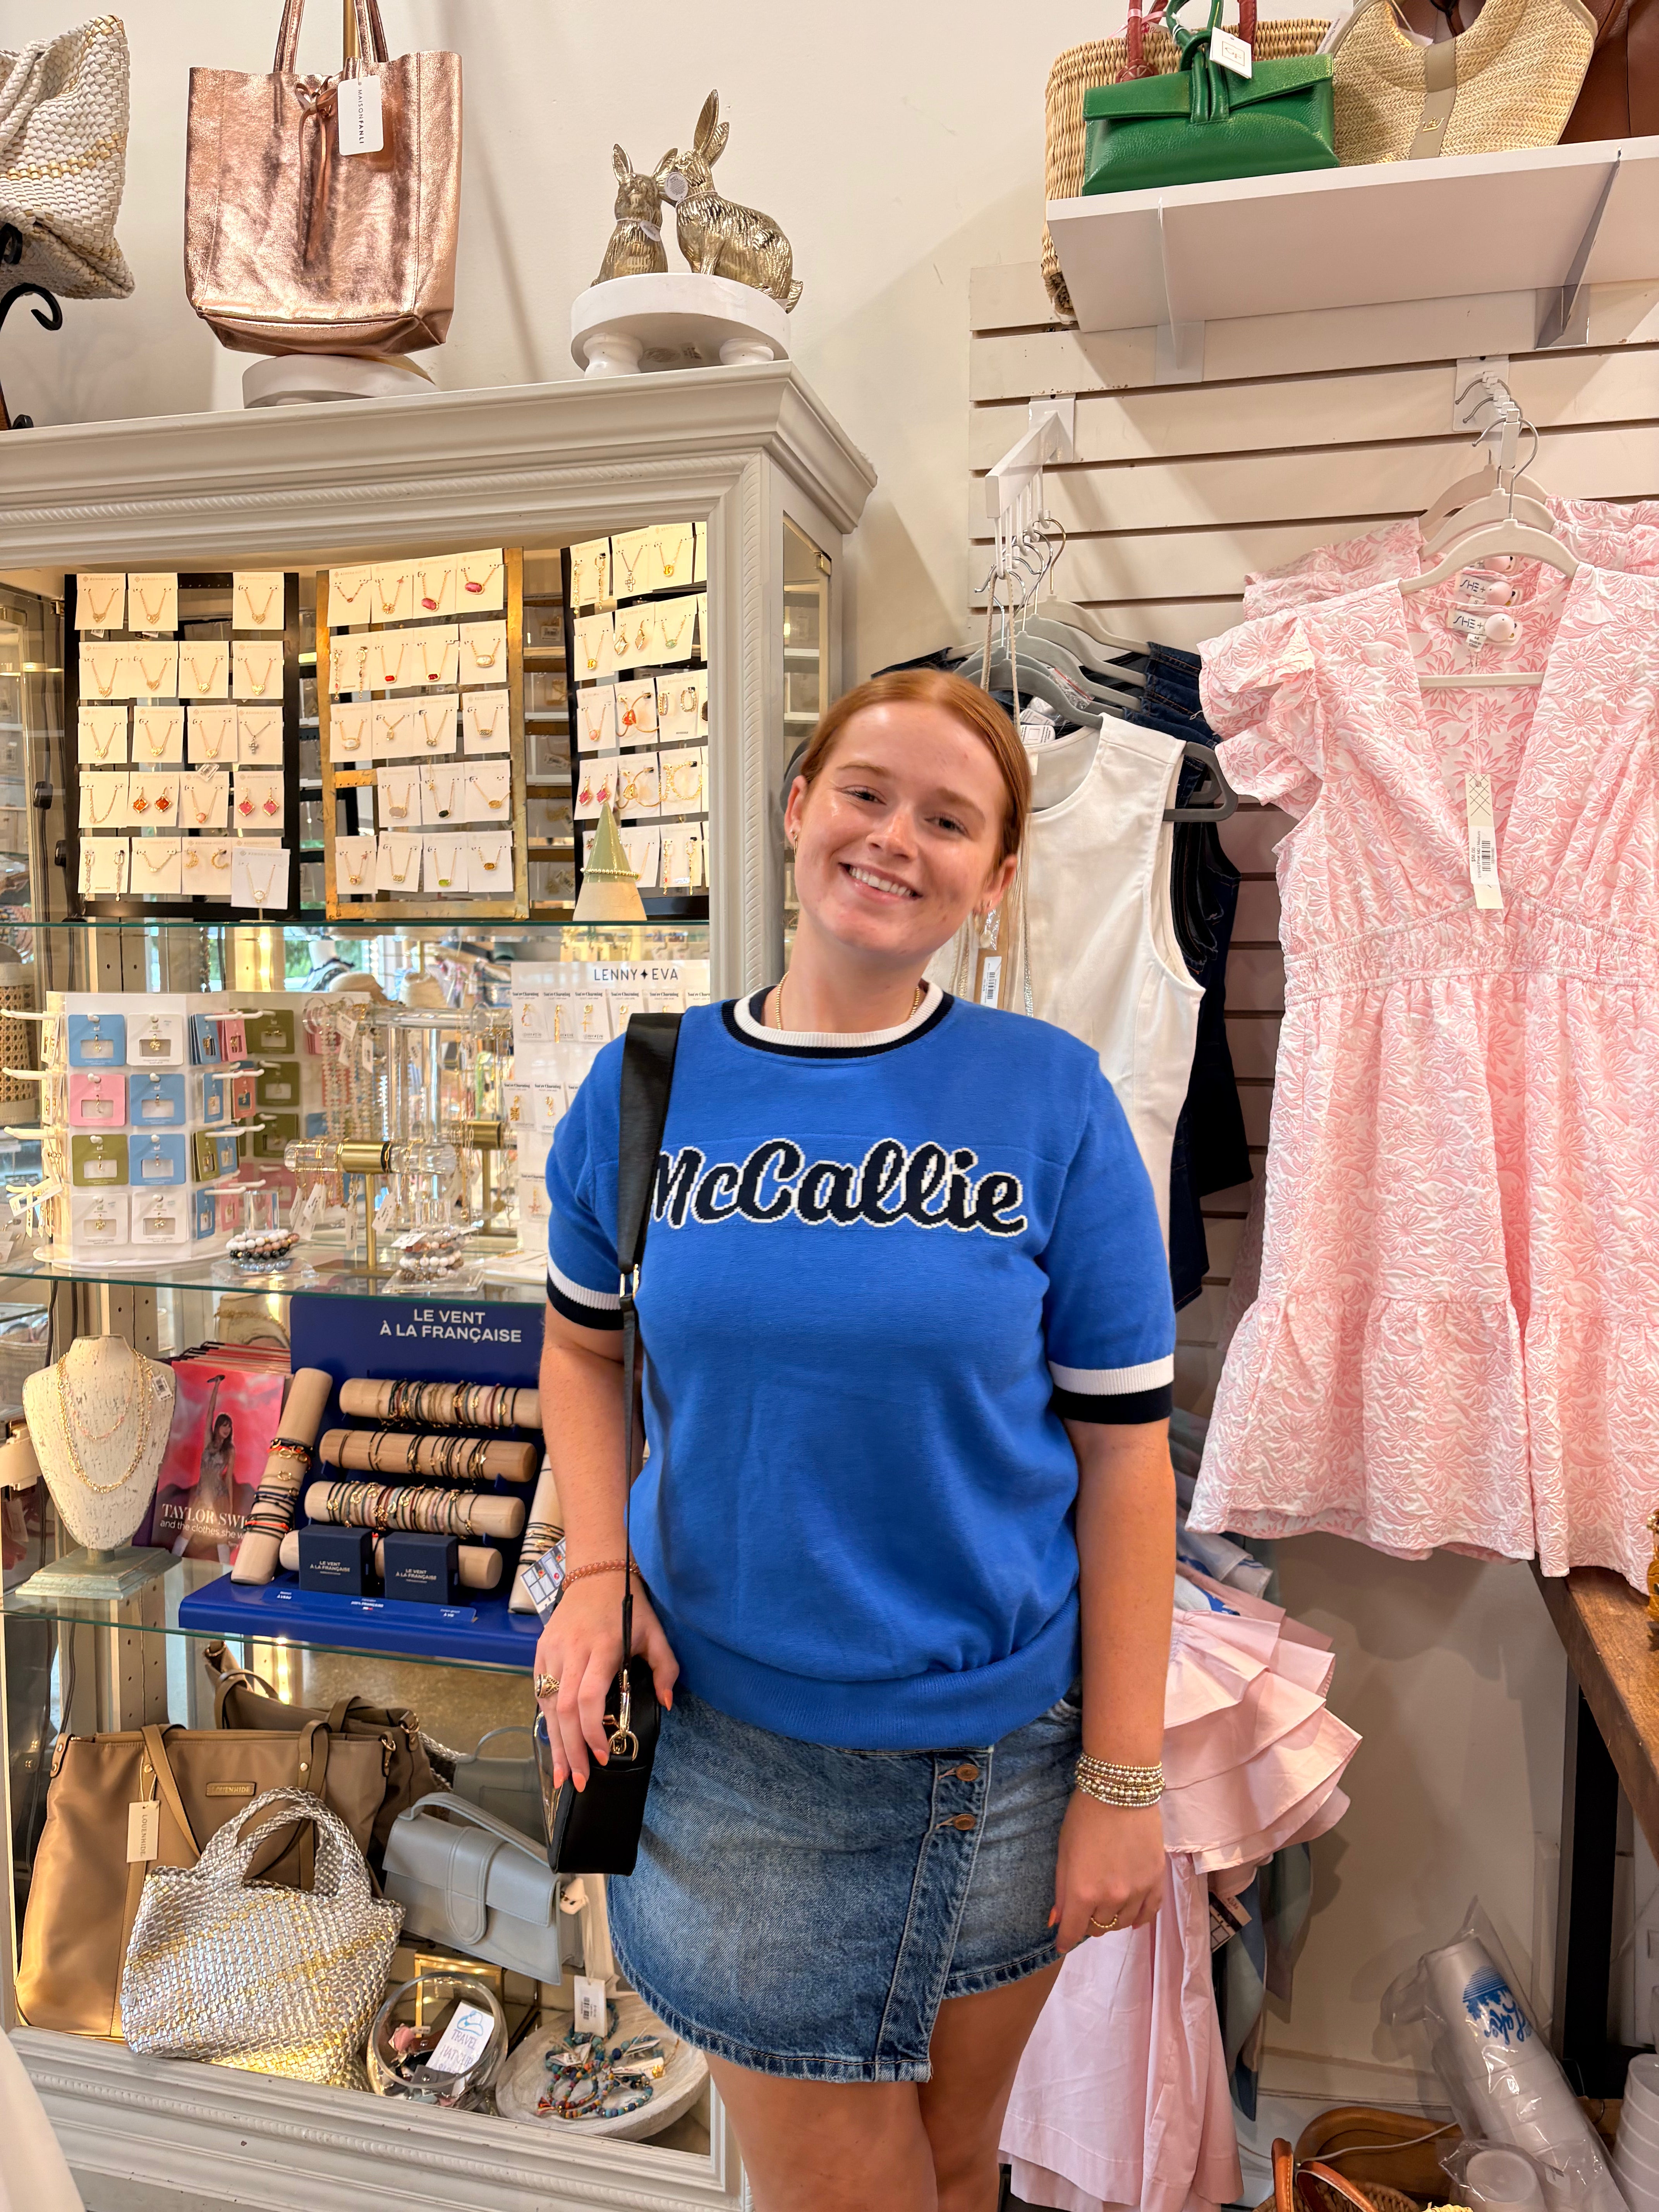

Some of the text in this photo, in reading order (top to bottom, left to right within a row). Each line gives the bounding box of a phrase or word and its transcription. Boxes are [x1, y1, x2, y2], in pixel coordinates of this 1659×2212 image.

[594, 968, 678, 981] LENNY EVA
[652, 1138, 1028, 1237] McCallie
[413, 1309, 486, 1324] LE VENT
[380, 1320, 522, 1343] À LA FRANÇAISE
[162, 1504, 214, 1524] TAYLOR
[160, 1520, 176, 1528] and
[177, 1522, 190, 1531] the
[192, 1524, 220, 1536] clothes
[222, 1528, 235, 1538] she
[451, 2029, 477, 2050] TRAVEL
